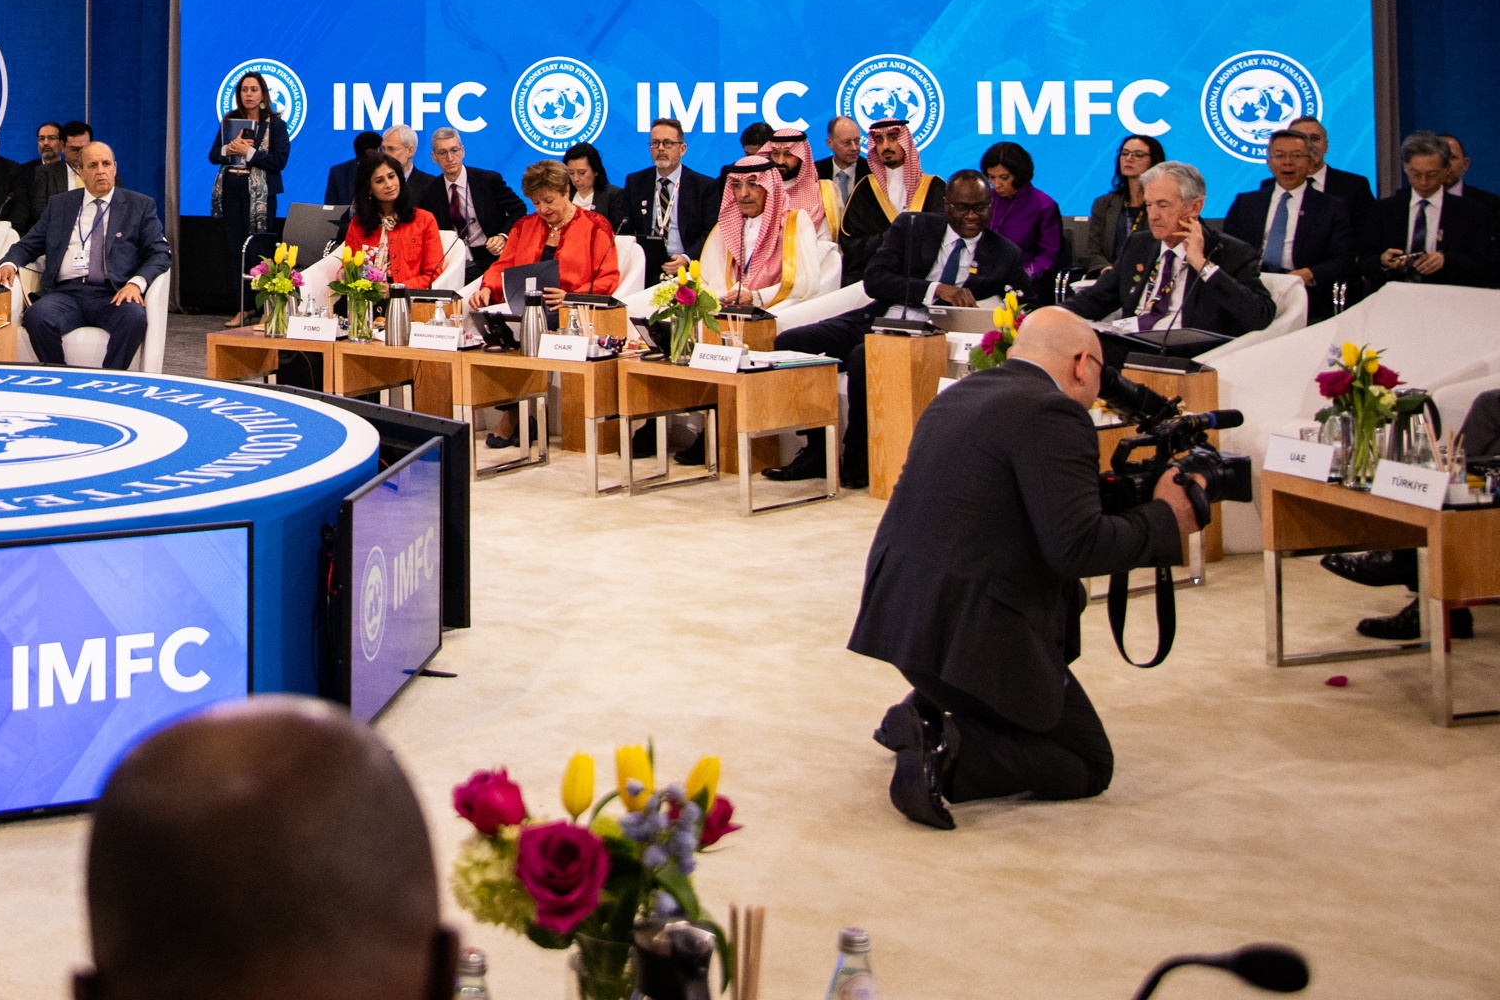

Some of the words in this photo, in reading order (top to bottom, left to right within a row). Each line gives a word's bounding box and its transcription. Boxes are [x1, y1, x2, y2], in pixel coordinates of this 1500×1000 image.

[525, 63, 559, 87] MONETARY
[559, 63, 575, 72] AND
[850, 61, 888, 86] MONETARY
[888, 61, 907, 70] AND
[906, 66, 936, 101] FINANCIAL
[1218, 58, 1259, 85] MONETARY
[1260, 58, 1280, 68] AND
[1279, 63, 1314, 101] FINANCIAL
[262, 65, 277, 73] AND
[276, 68, 300, 101] FINANCIAL
[575, 67, 600, 101] FINANCIAL
[333, 81, 488, 133] IMFC
[518, 88, 541, 142] INTERNATIONAL
[578, 101, 602, 142] COMMITTEE
[636, 80, 810, 133] IMFC
[977, 78, 1172, 137] IMFC
[1209, 85, 1239, 148] INTERNATIONAL
[1251, 148, 1267, 156] IM
[554, 343, 572, 351] CHAIR
[699, 352, 733, 362] SECRETARY
[68, 379, 299, 435] FINANCIAL
[1290, 452, 1306, 463] UAE
[393, 526, 435, 611] IMFC
[11, 626, 211, 711] IMFC
